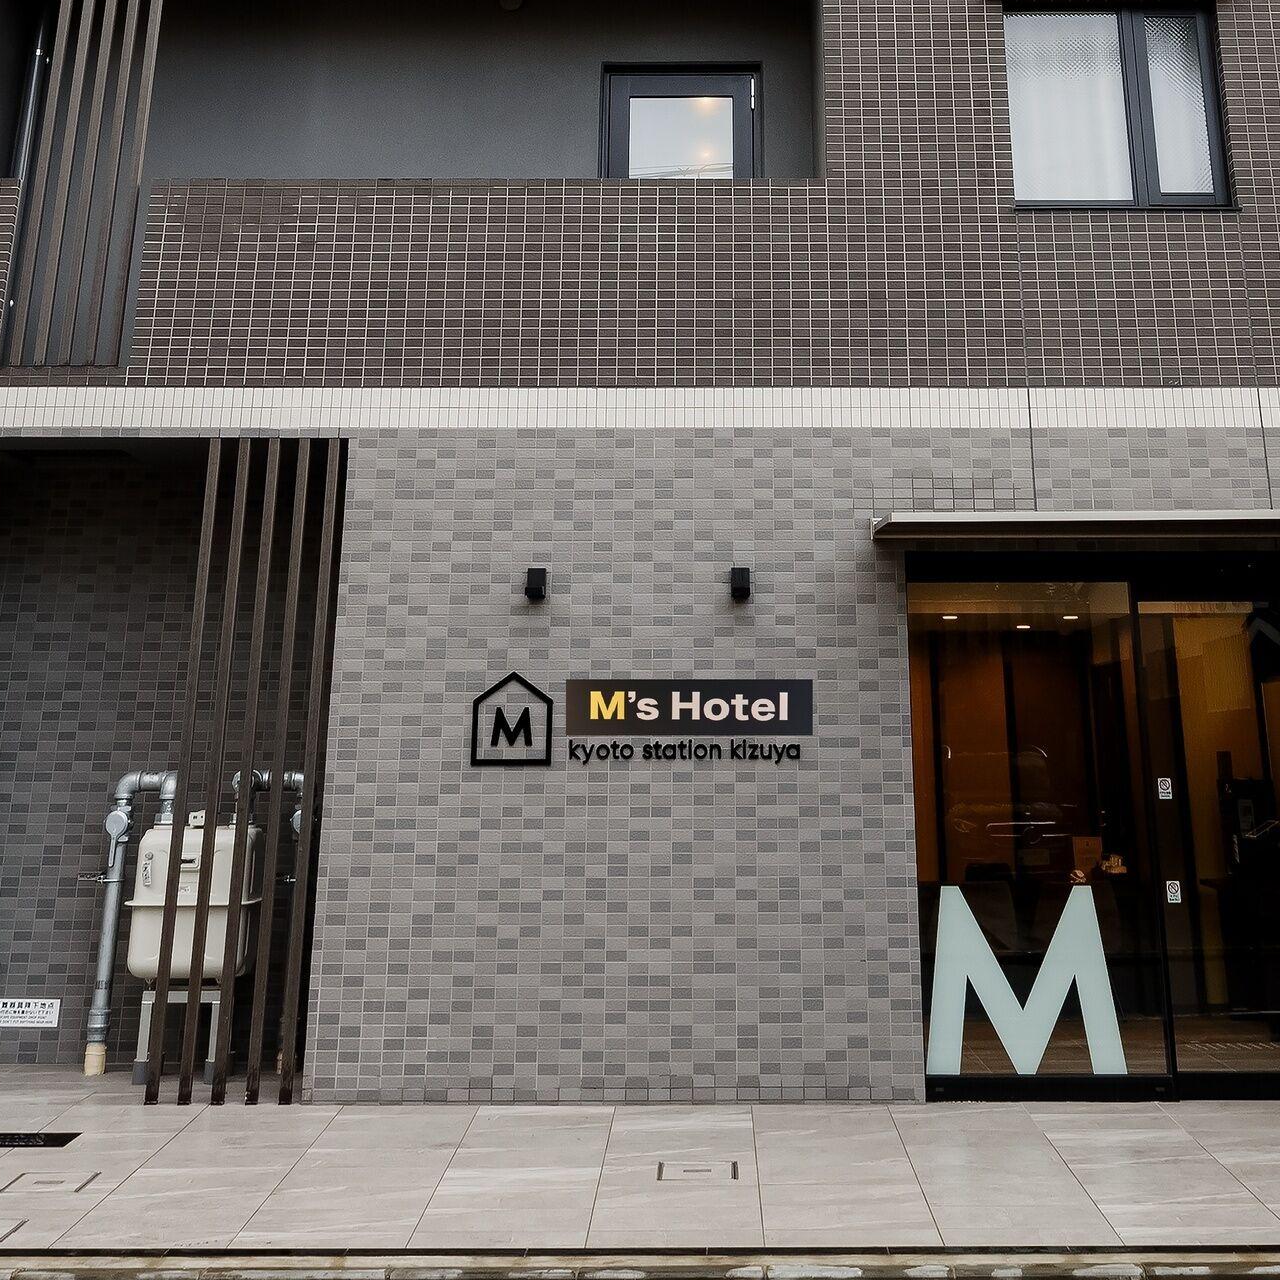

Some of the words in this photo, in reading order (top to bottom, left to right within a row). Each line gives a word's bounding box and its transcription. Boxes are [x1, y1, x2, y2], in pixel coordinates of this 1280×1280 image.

[671, 691, 789, 721] Hotel
[489, 705, 534, 747] M
[568, 739, 635, 765] kyoto
[642, 739, 722, 760] station
[730, 739, 801, 765] kizuya
[926, 885, 1128, 1074] M
